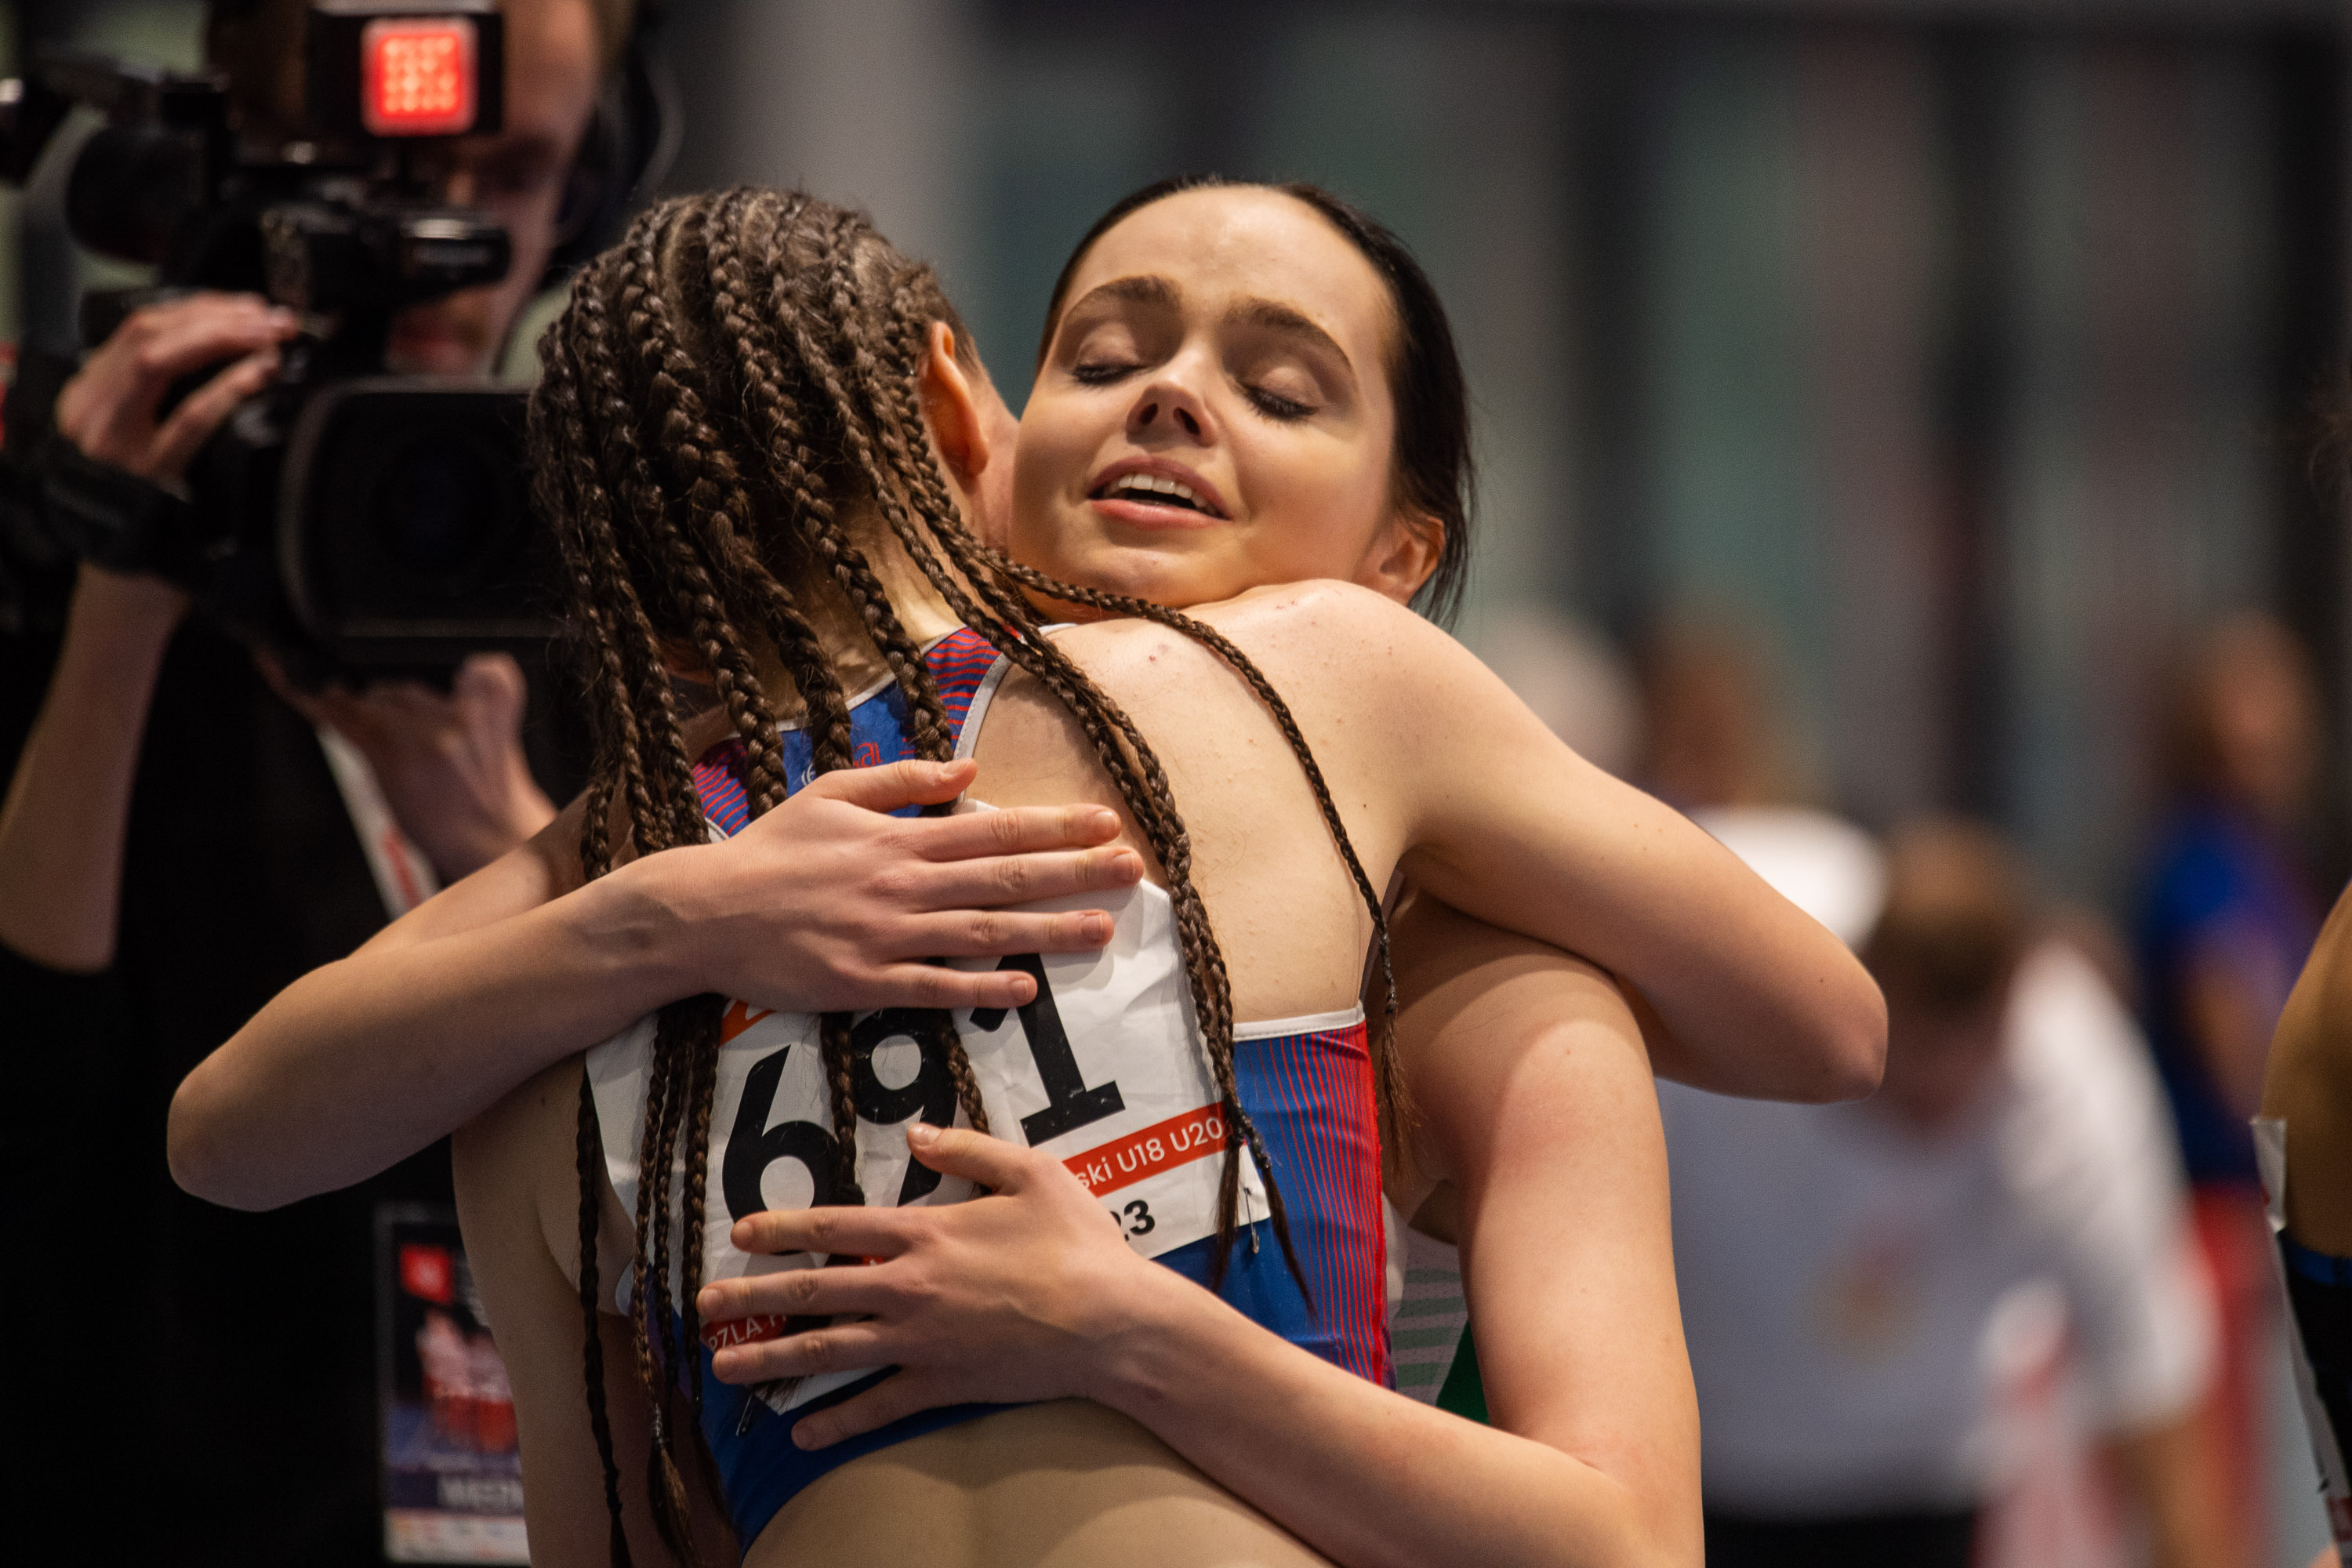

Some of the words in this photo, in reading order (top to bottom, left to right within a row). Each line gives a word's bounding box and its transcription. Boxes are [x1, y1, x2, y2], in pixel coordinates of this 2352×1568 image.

[722, 953, 1125, 1254] 691
[1116, 1138, 1165, 1172] U18
[1170, 1117, 1223, 1152] U20
